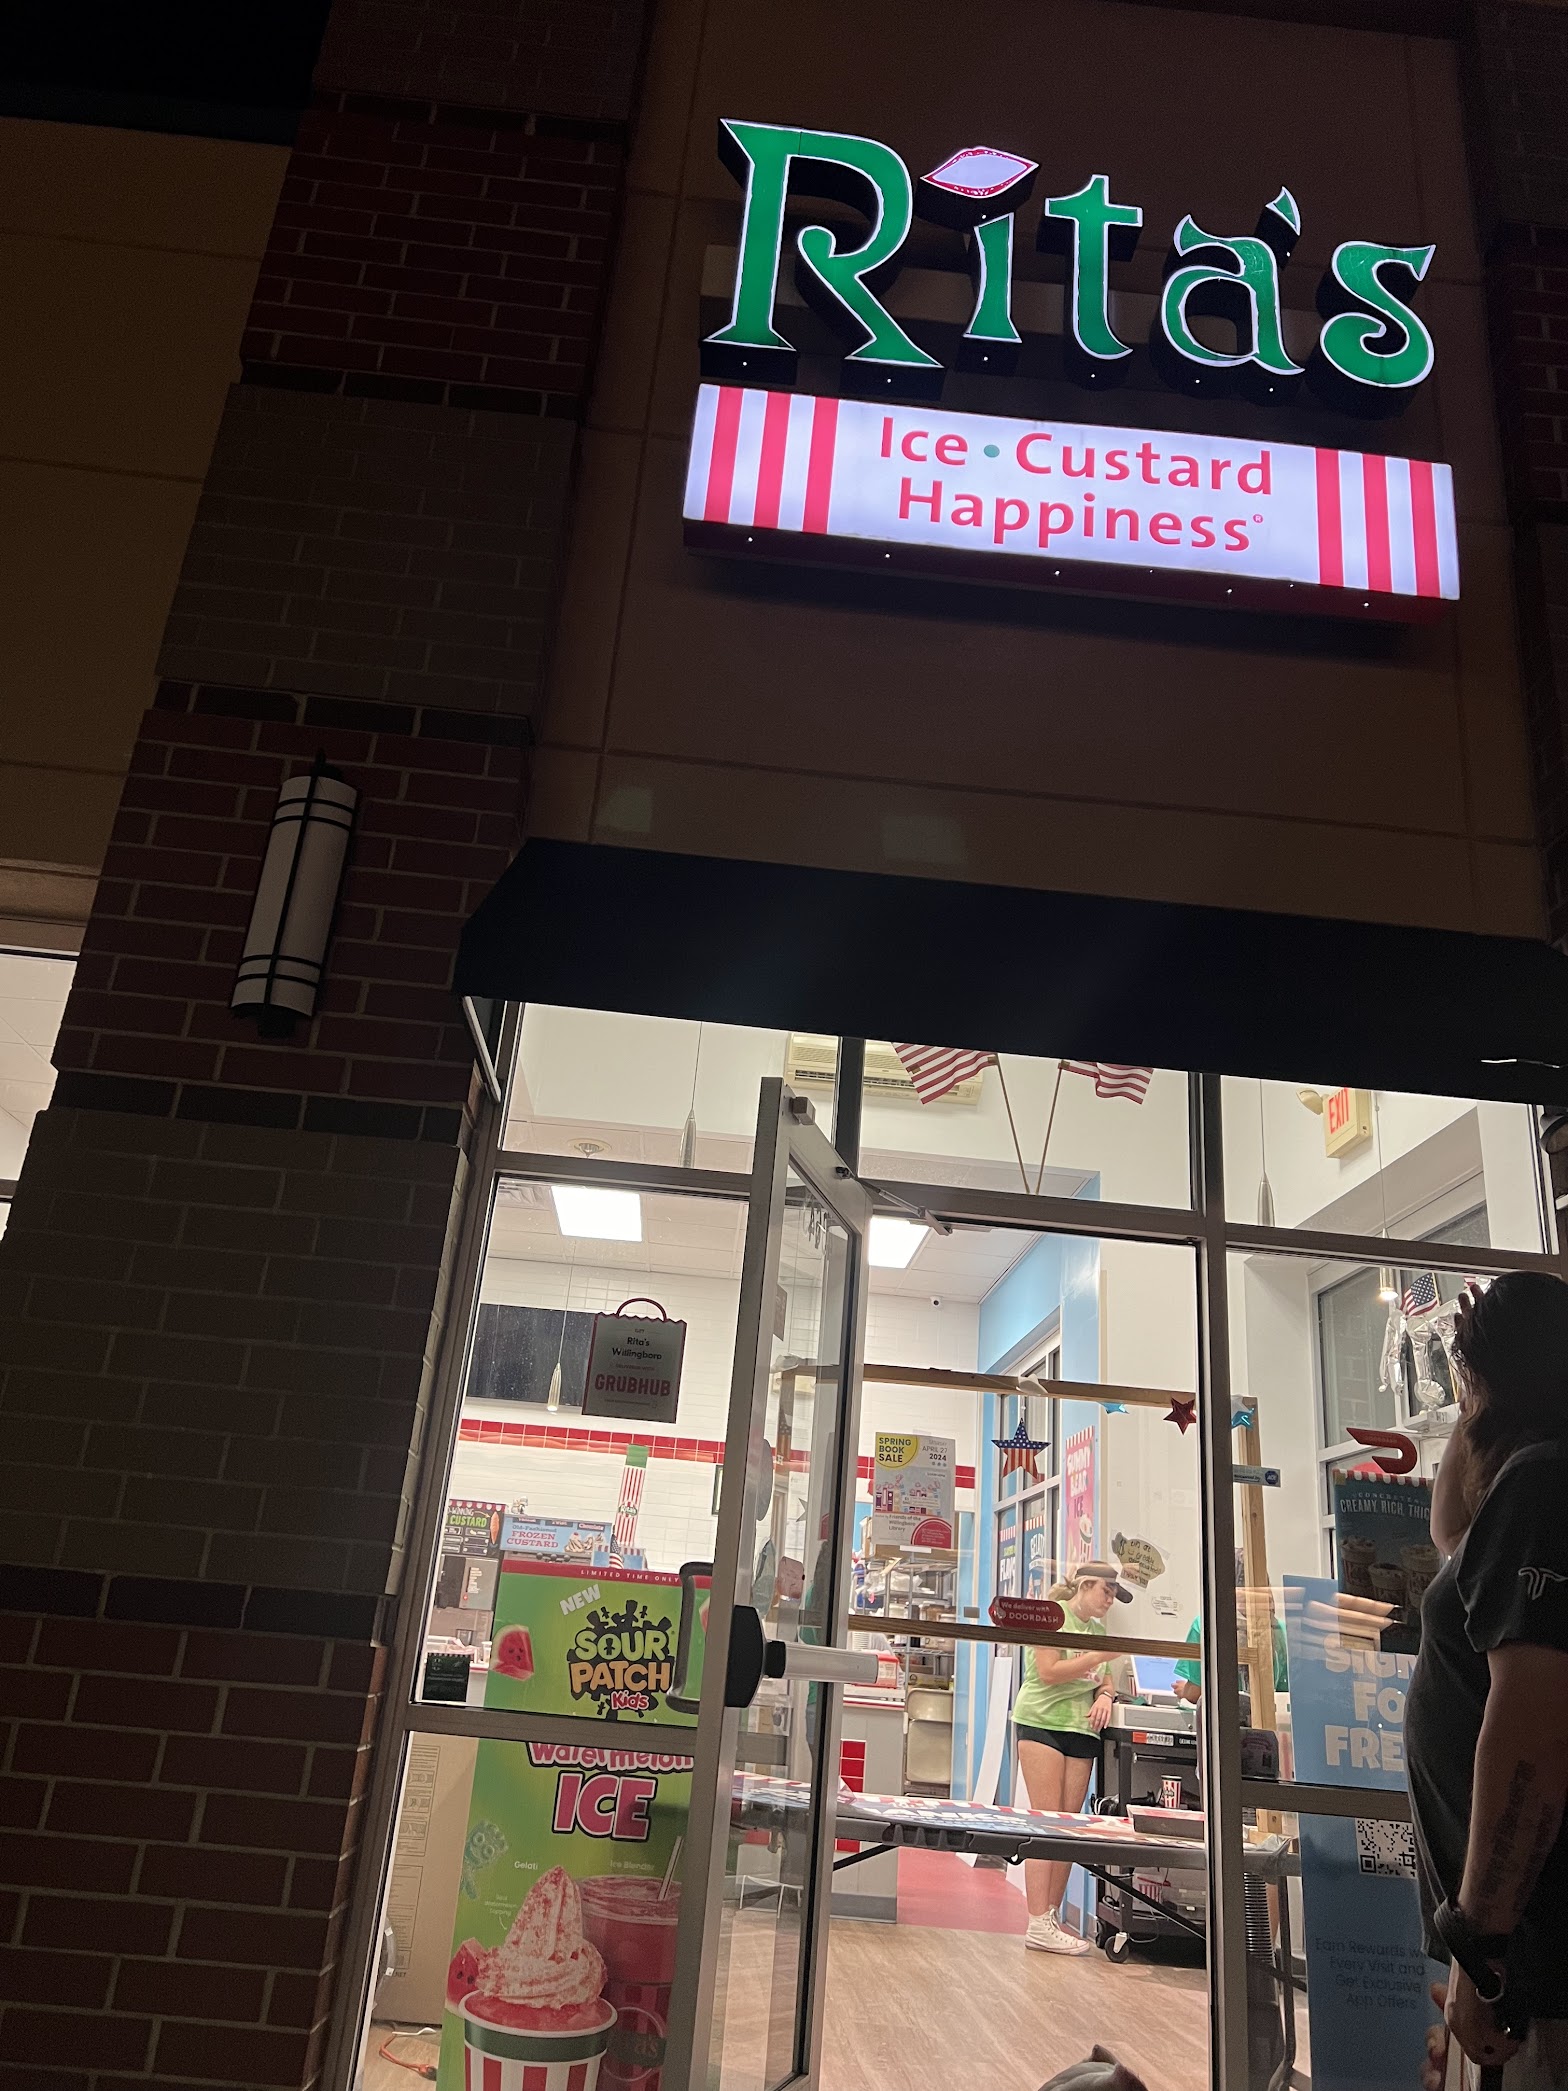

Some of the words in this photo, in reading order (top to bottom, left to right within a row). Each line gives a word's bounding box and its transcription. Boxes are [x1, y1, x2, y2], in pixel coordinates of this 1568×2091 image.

[702, 118, 1437, 388] Rita's
[880, 416, 969, 466] Ice
[1015, 431, 1272, 496] Custard
[1328, 1086, 1349, 1135] EXIT
[626, 1336, 650, 1347] Rita's
[611, 1347, 662, 1360] Willingboro
[594, 1373, 671, 1397] GRUBHUB
[878, 1437, 912, 1446] SPRING
[879, 1445, 905, 1454] BOOK
[922, 1445, 939, 1454] APRIL
[878, 1453, 903, 1463] SALE
[929, 1453, 947, 1461] 2024
[1073, 1495, 1084, 1519] ICE
[1408, 1503, 1430, 1520] THIC
[450, 1515, 488, 1528] CUSTARD
[506, 1538, 559, 1549] CUSTARD
[511, 1530, 556, 1540] FROZEN
[580, 1569, 621, 1579] LIMITED
[559, 1583, 601, 1616] NEW
[1001, 1601, 1012, 1609] We
[1009, 1611, 1059, 1623] DOORDASH
[575, 1629, 668, 1662] SOUR
[570, 1660, 671, 1694] PATCH
[610, 1690, 650, 1710] Kids
[1353, 1681, 1407, 1724] FO
[1325, 1724, 1405, 1772] FRE
[553, 1771, 657, 1841] ICE
[514, 1861, 539, 1870] Gelati
[1315, 1937, 1346, 1953] Earn
[1348, 1940, 1406, 1956] Rewards
[1330, 1956, 1365, 1971] Every
[1369, 1958, 1395, 1974] Visit
[1398, 1962, 1426, 1977] and
[1335, 1973, 1359, 1988] Get
[1362, 1976, 1422, 1993] Exclusive
[1347, 1992, 1374, 2010] App
[1378, 1994, 1417, 2010] Offers
